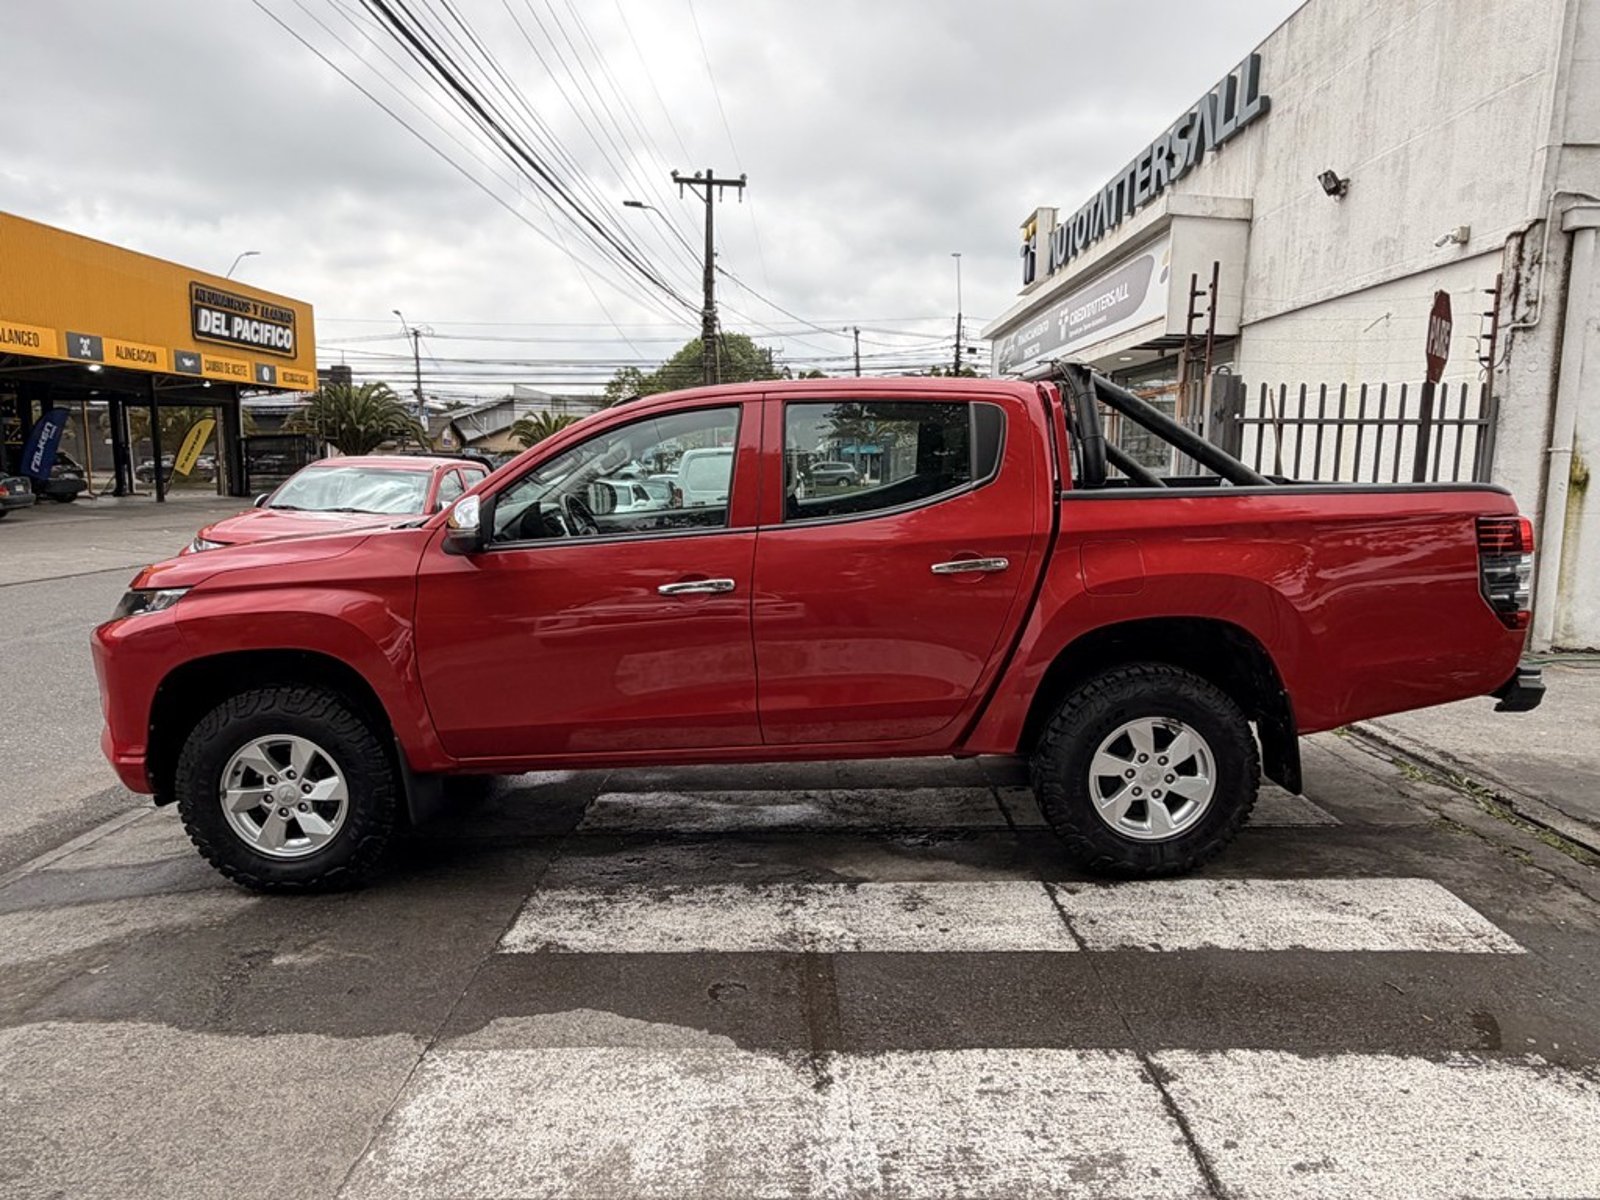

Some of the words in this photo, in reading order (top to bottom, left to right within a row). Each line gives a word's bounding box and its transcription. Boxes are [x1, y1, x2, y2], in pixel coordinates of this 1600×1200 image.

[0, 327, 40, 347] LANCEO
[198, 308, 230, 337] DEL
[231, 316, 293, 350] PACIFICO
